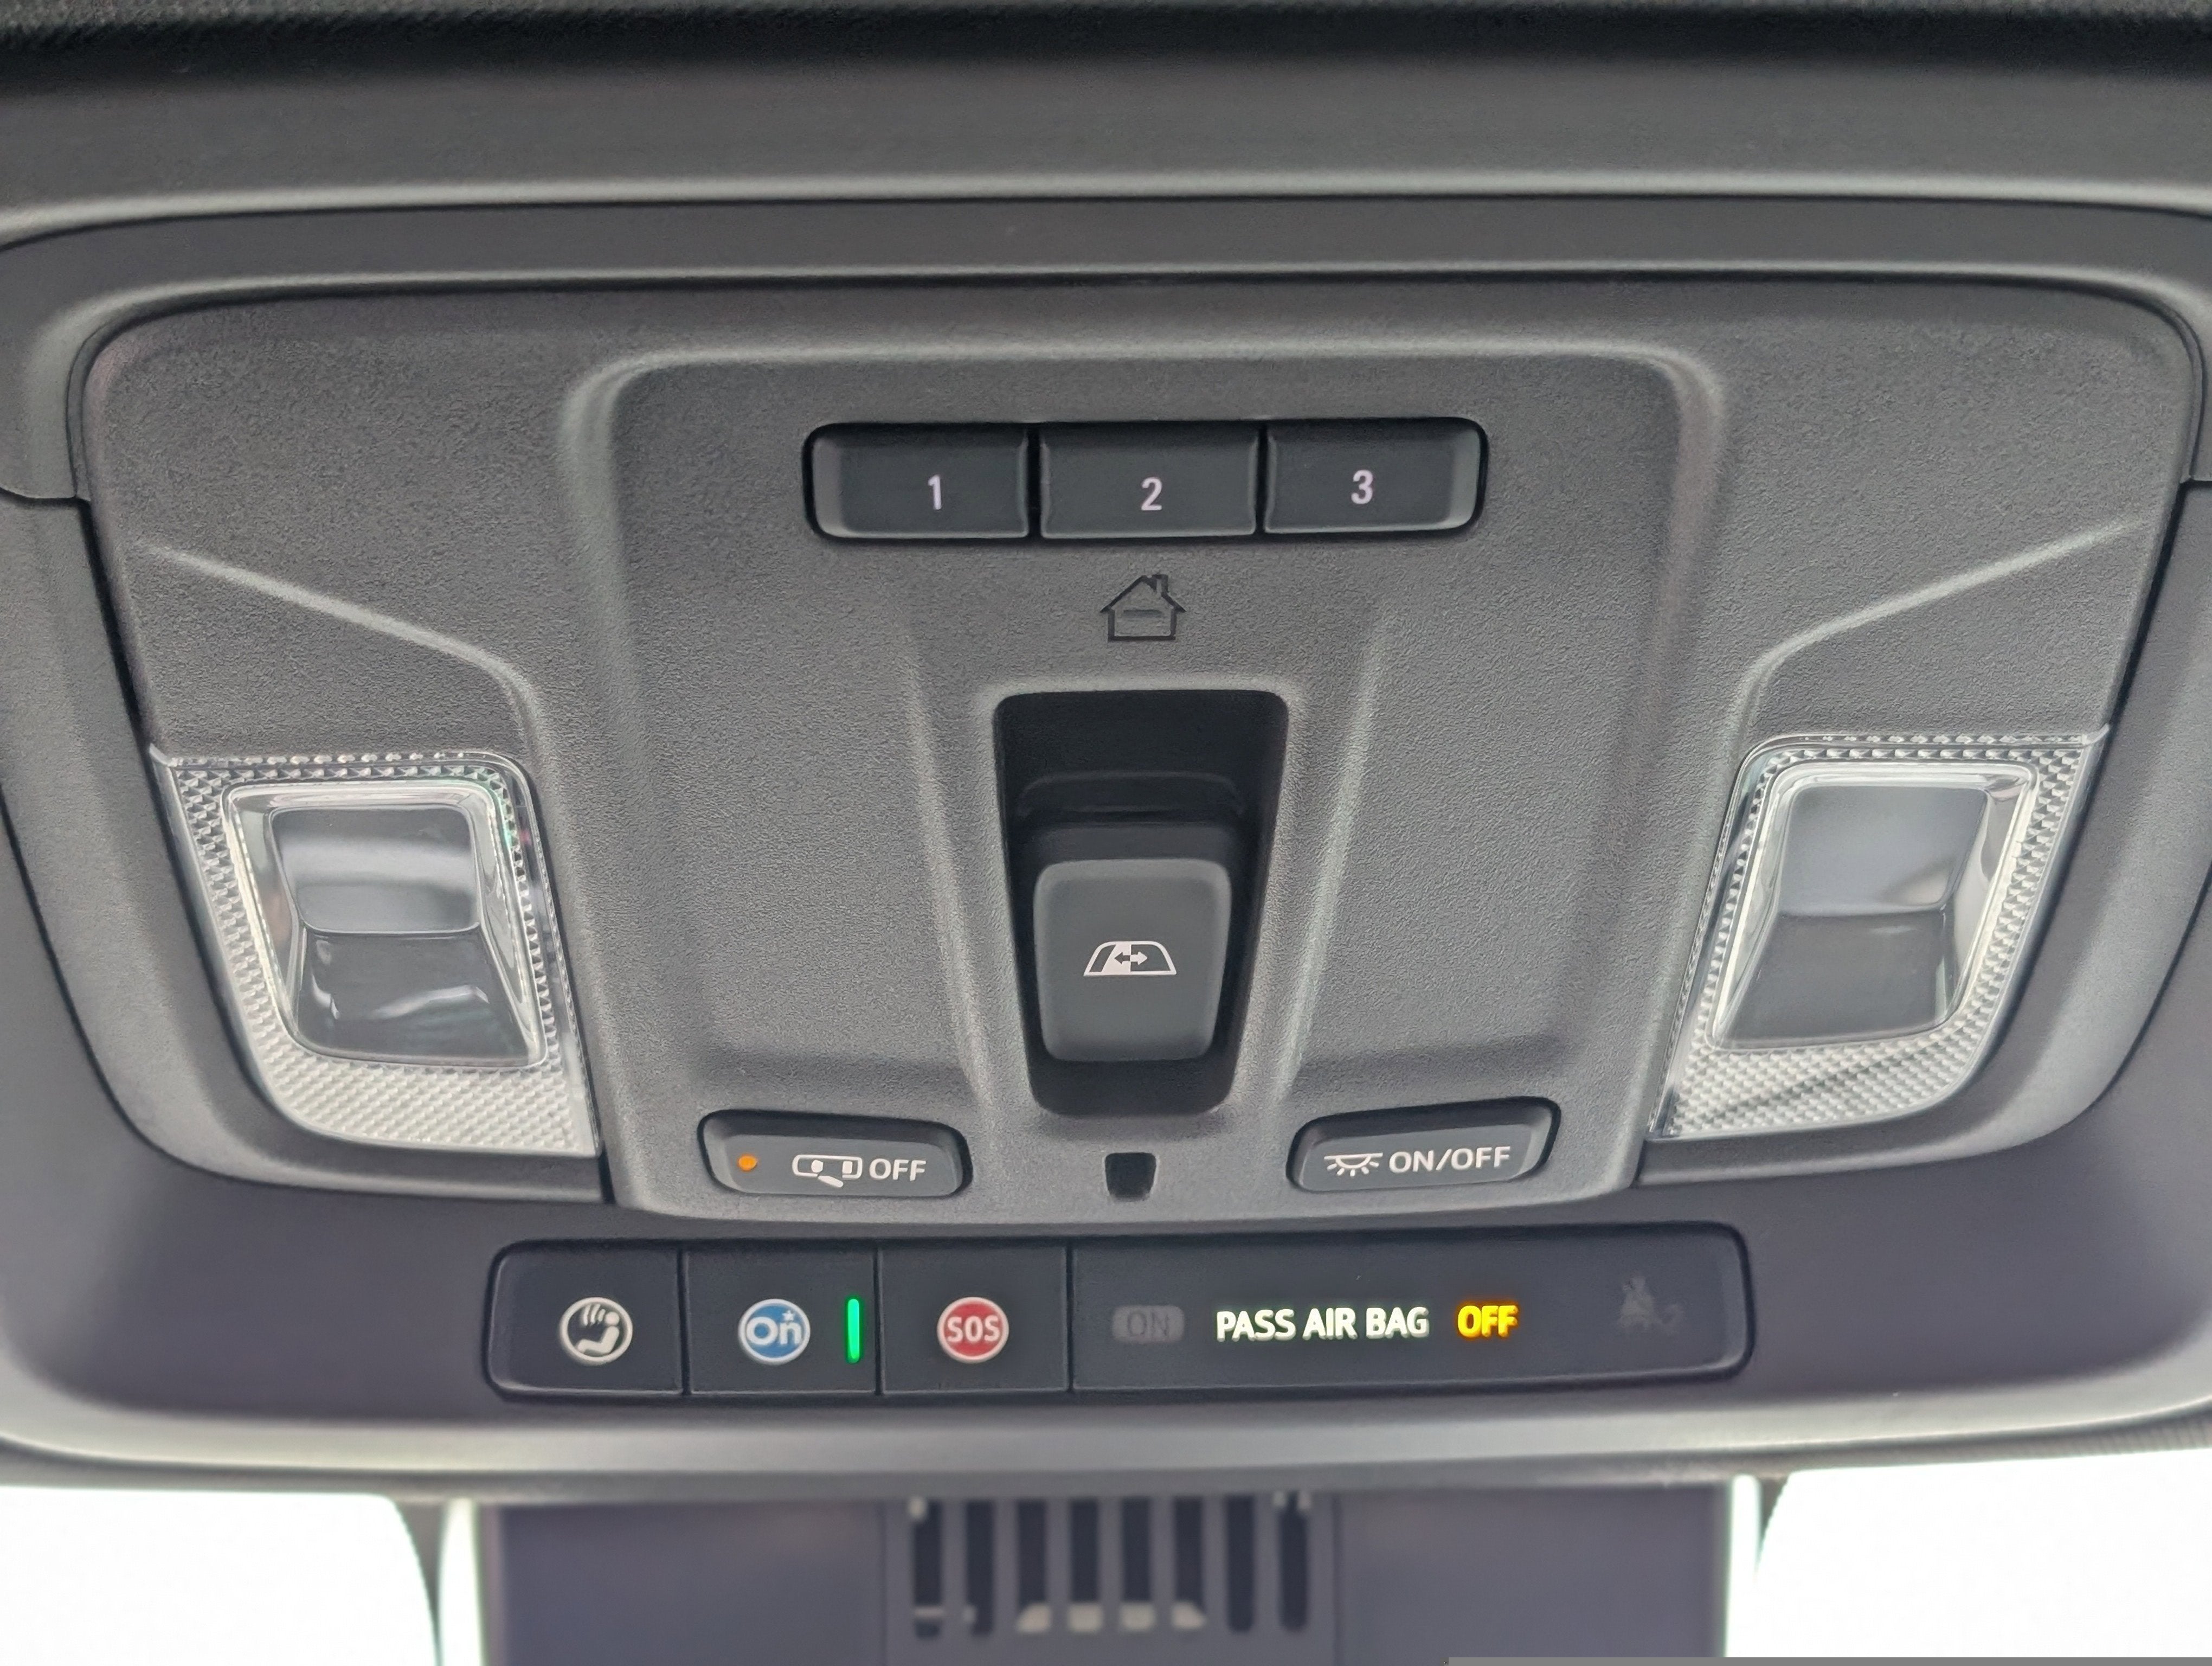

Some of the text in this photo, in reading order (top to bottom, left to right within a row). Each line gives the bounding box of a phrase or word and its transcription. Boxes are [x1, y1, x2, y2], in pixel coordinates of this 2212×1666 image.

[927, 475, 942, 510] 1
[1141, 477, 1163, 511] 2
[1351, 470, 1374, 504] 3
[869, 1158, 927, 1181] OFF
[1388, 1146, 1511, 1174] ON/OFF
[946, 1314, 1000, 1343] SOS
[1128, 1311, 1170, 1336] ON
[1216, 1305, 1518, 1342] PASS AIR BAG OFF
